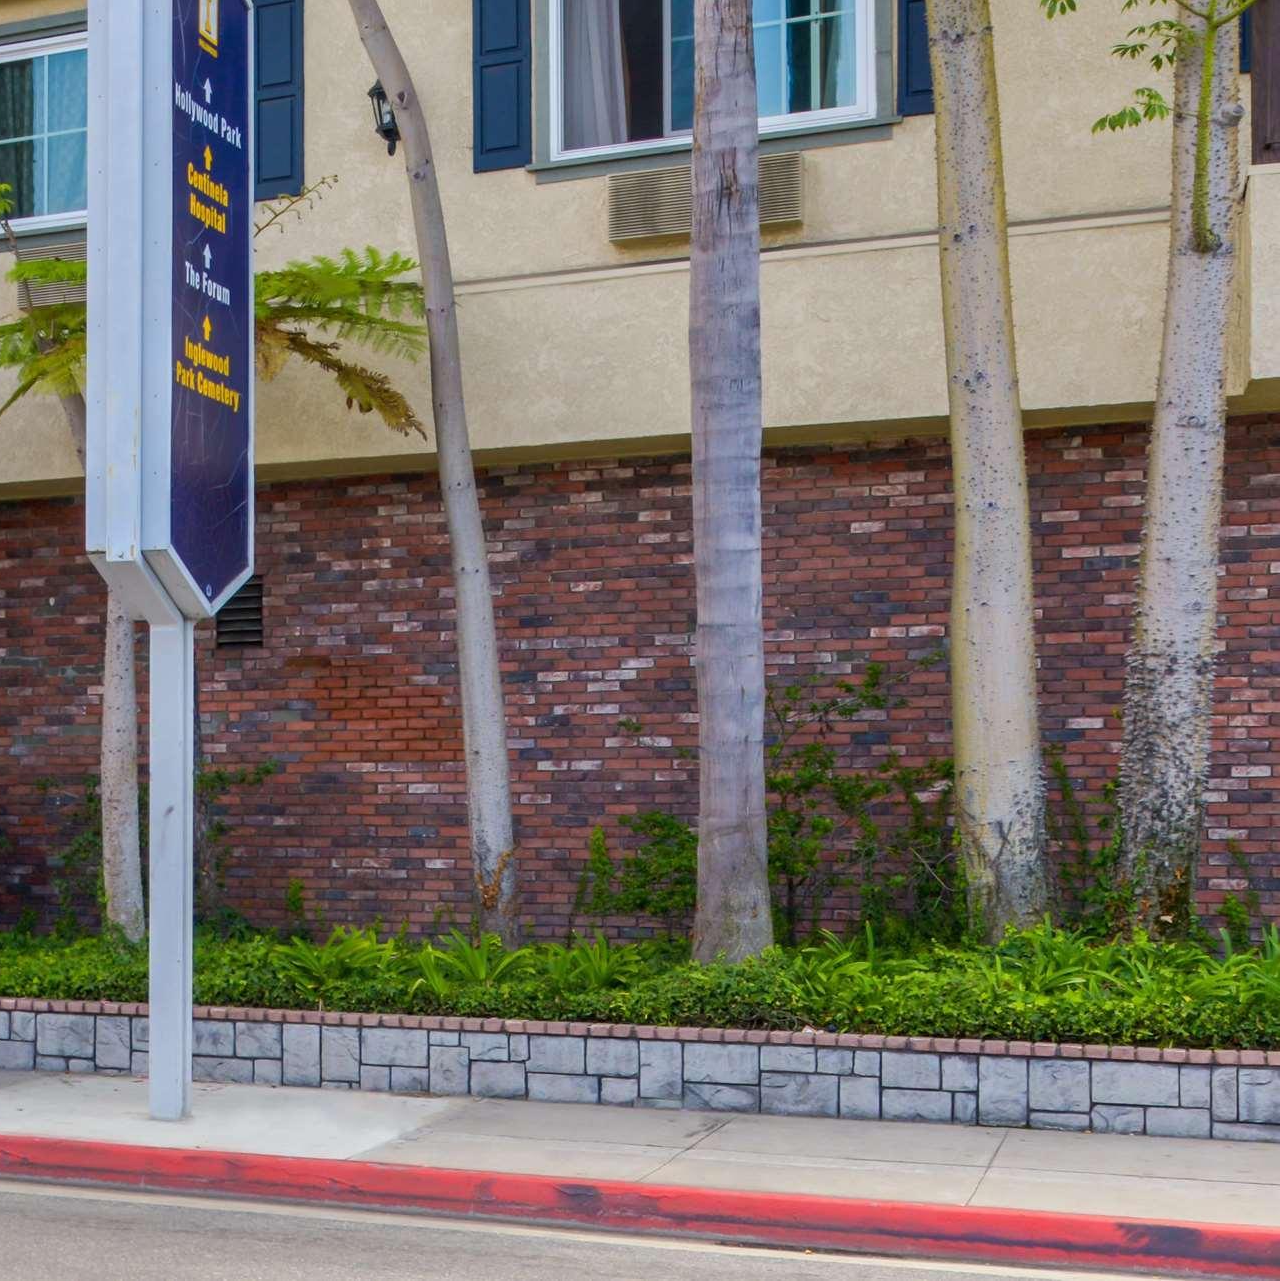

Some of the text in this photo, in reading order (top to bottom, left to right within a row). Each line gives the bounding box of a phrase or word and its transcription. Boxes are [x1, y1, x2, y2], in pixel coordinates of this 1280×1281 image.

[175, 81, 242, 150] Hollywood Park
[187, 161, 229, 208] Centinela
[189, 192, 226, 235] Hospital
[185, 260, 231, 306] The Forum
[185, 335, 229, 377] Inglewood
[176, 360, 239, 413] Park Cemetery
